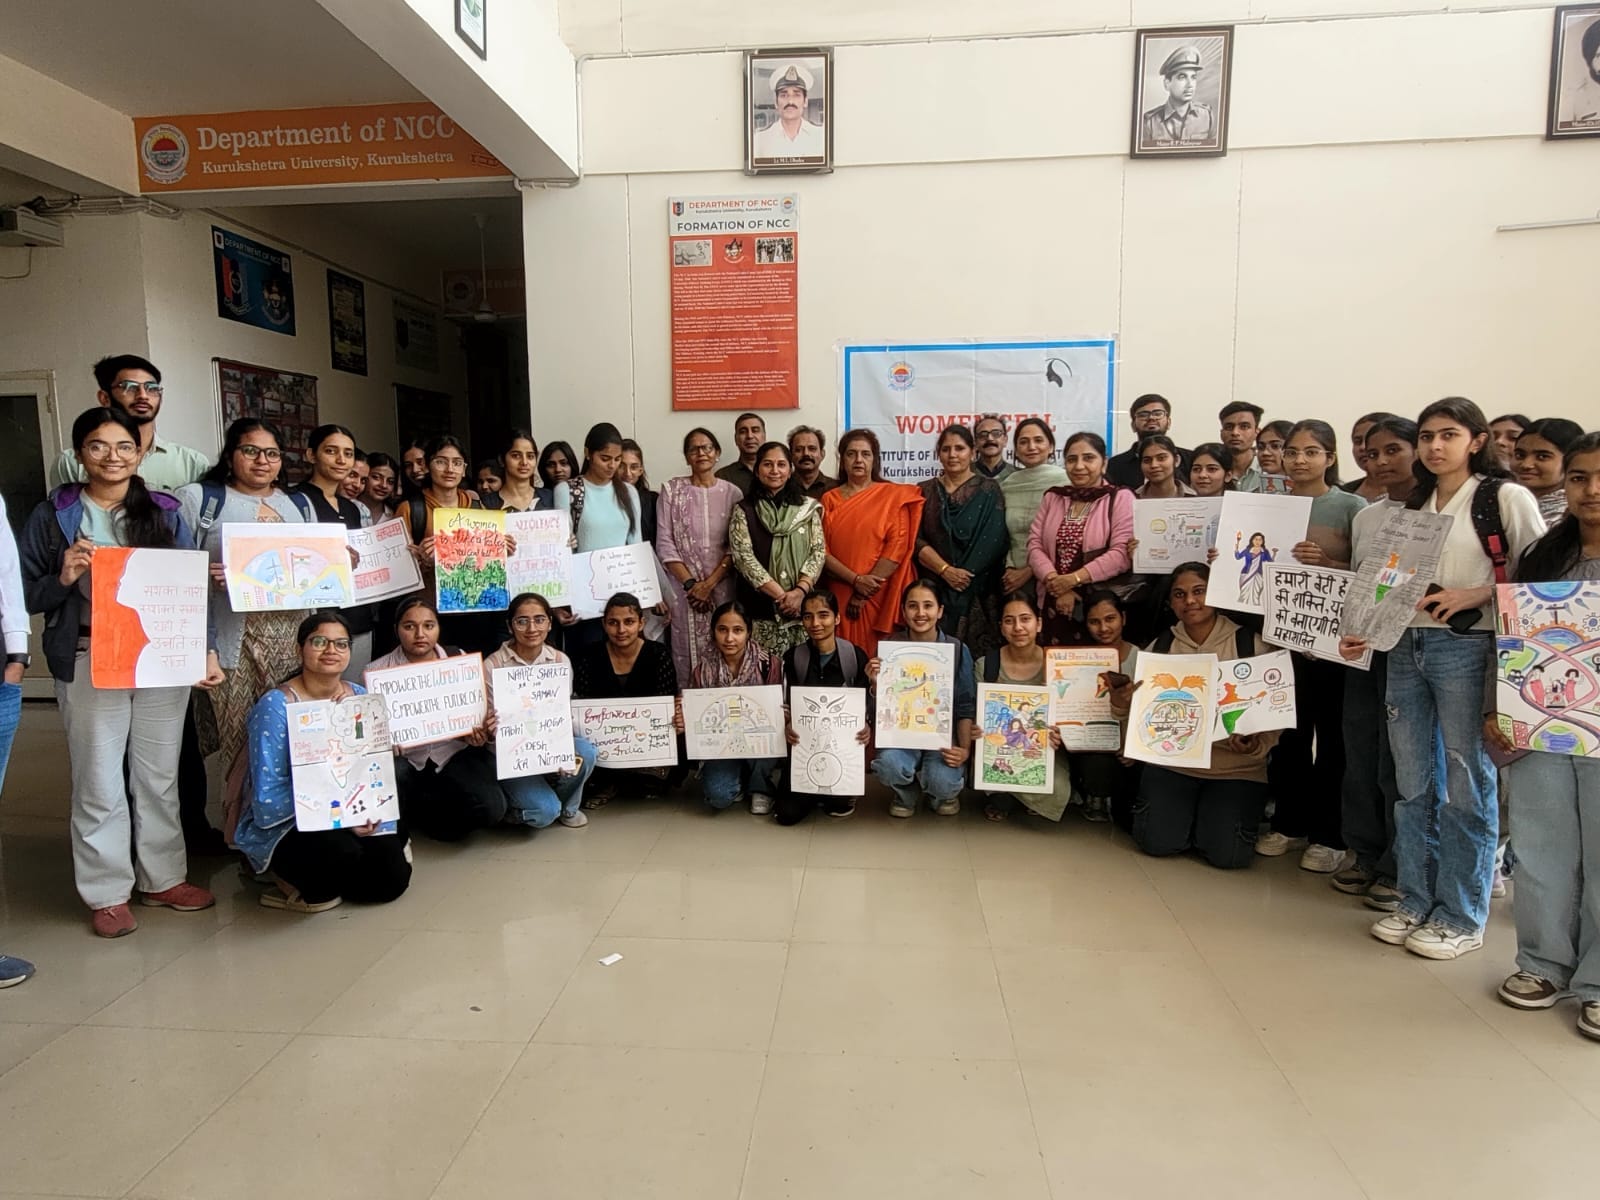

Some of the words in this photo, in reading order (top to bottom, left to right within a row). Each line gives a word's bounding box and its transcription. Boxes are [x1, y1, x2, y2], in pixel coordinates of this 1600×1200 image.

[196, 121, 352, 156] Department
[360, 117, 386, 142] of
[393, 114, 455, 141] NCC
[202, 159, 287, 174] Kurukshetra
[290, 155, 364, 170] University,
[367, 151, 454, 166] Kurukshetra
[688, 200, 745, 209] DEPARTMENT
[747, 199, 760, 207] OF
[760, 199, 779, 207] NCC
[677, 220, 745, 232] FORMATION
[748, 219, 764, 229] OF
[766, 218, 791, 229] NCC
[918, 450, 931, 461] OF
[883, 466, 945, 478] Kurukshetra
[1275, 571, 1312, 590] हमारी
[1314, 573, 1337, 595] बेटी
[1275, 588, 1291, 606] की
[1273, 626, 1317, 650] महाशक्ति
